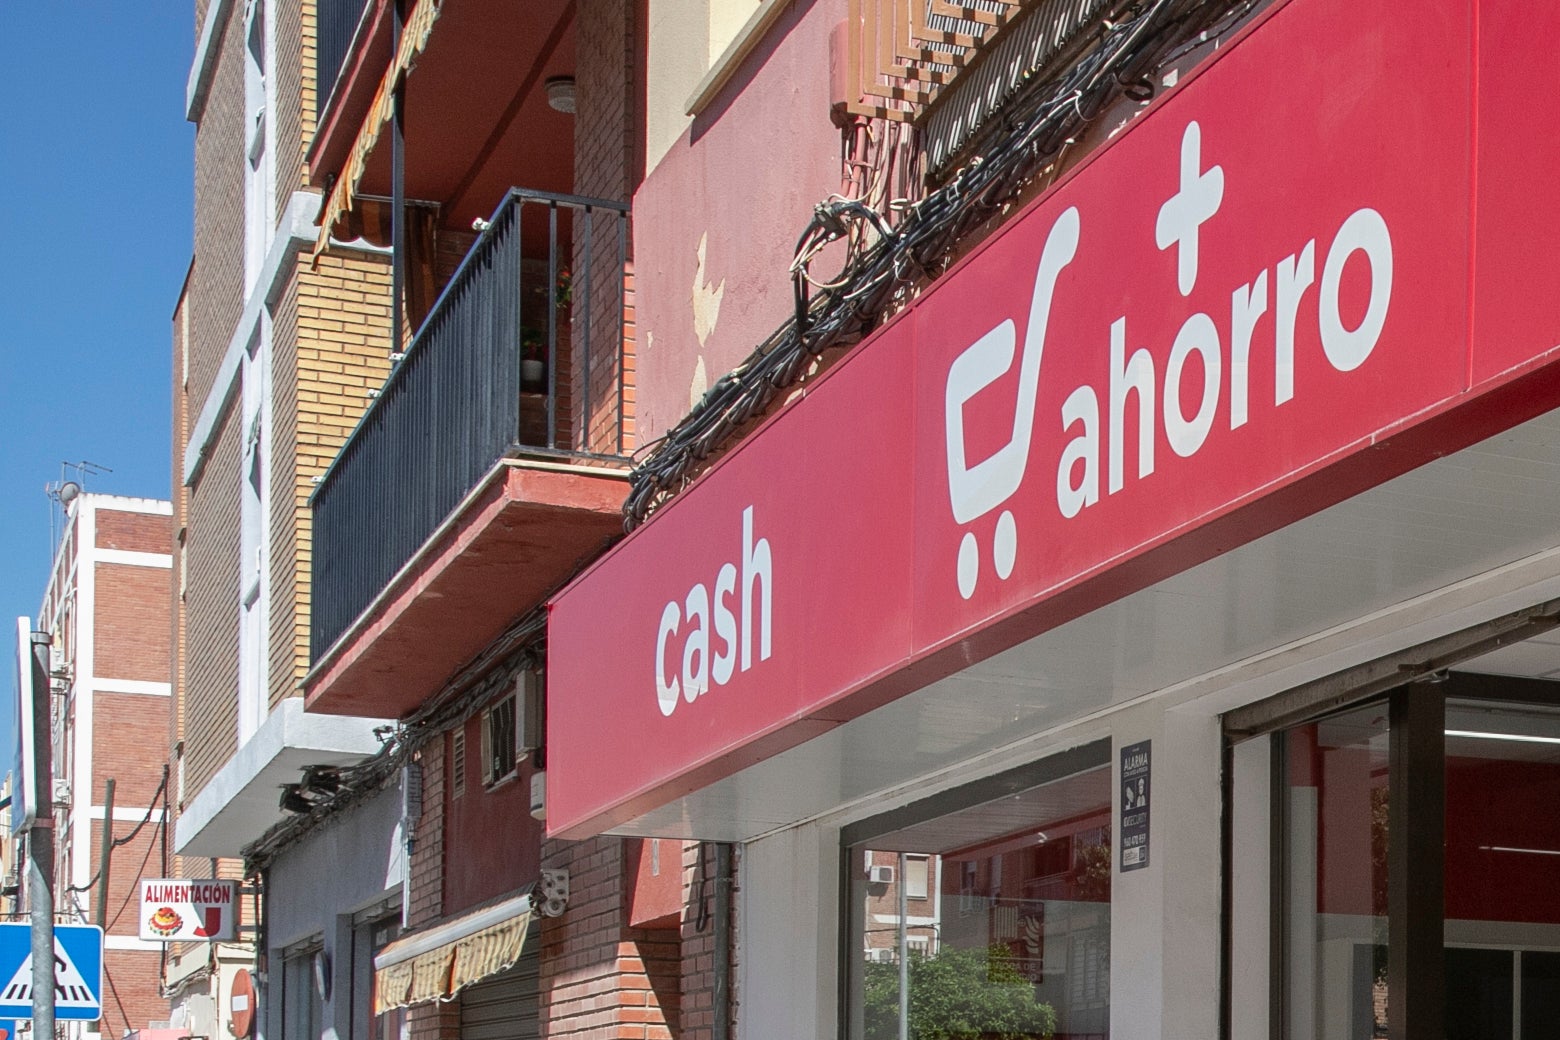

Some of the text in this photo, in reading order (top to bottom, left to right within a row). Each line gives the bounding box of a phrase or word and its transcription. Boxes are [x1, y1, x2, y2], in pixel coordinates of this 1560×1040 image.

[1056, 208, 1394, 519] ahorro
[654, 505, 773, 717] cash
[1124, 752, 1148, 772] ALARMA
[145, 883, 231, 904] ALIMENTACIÓN
